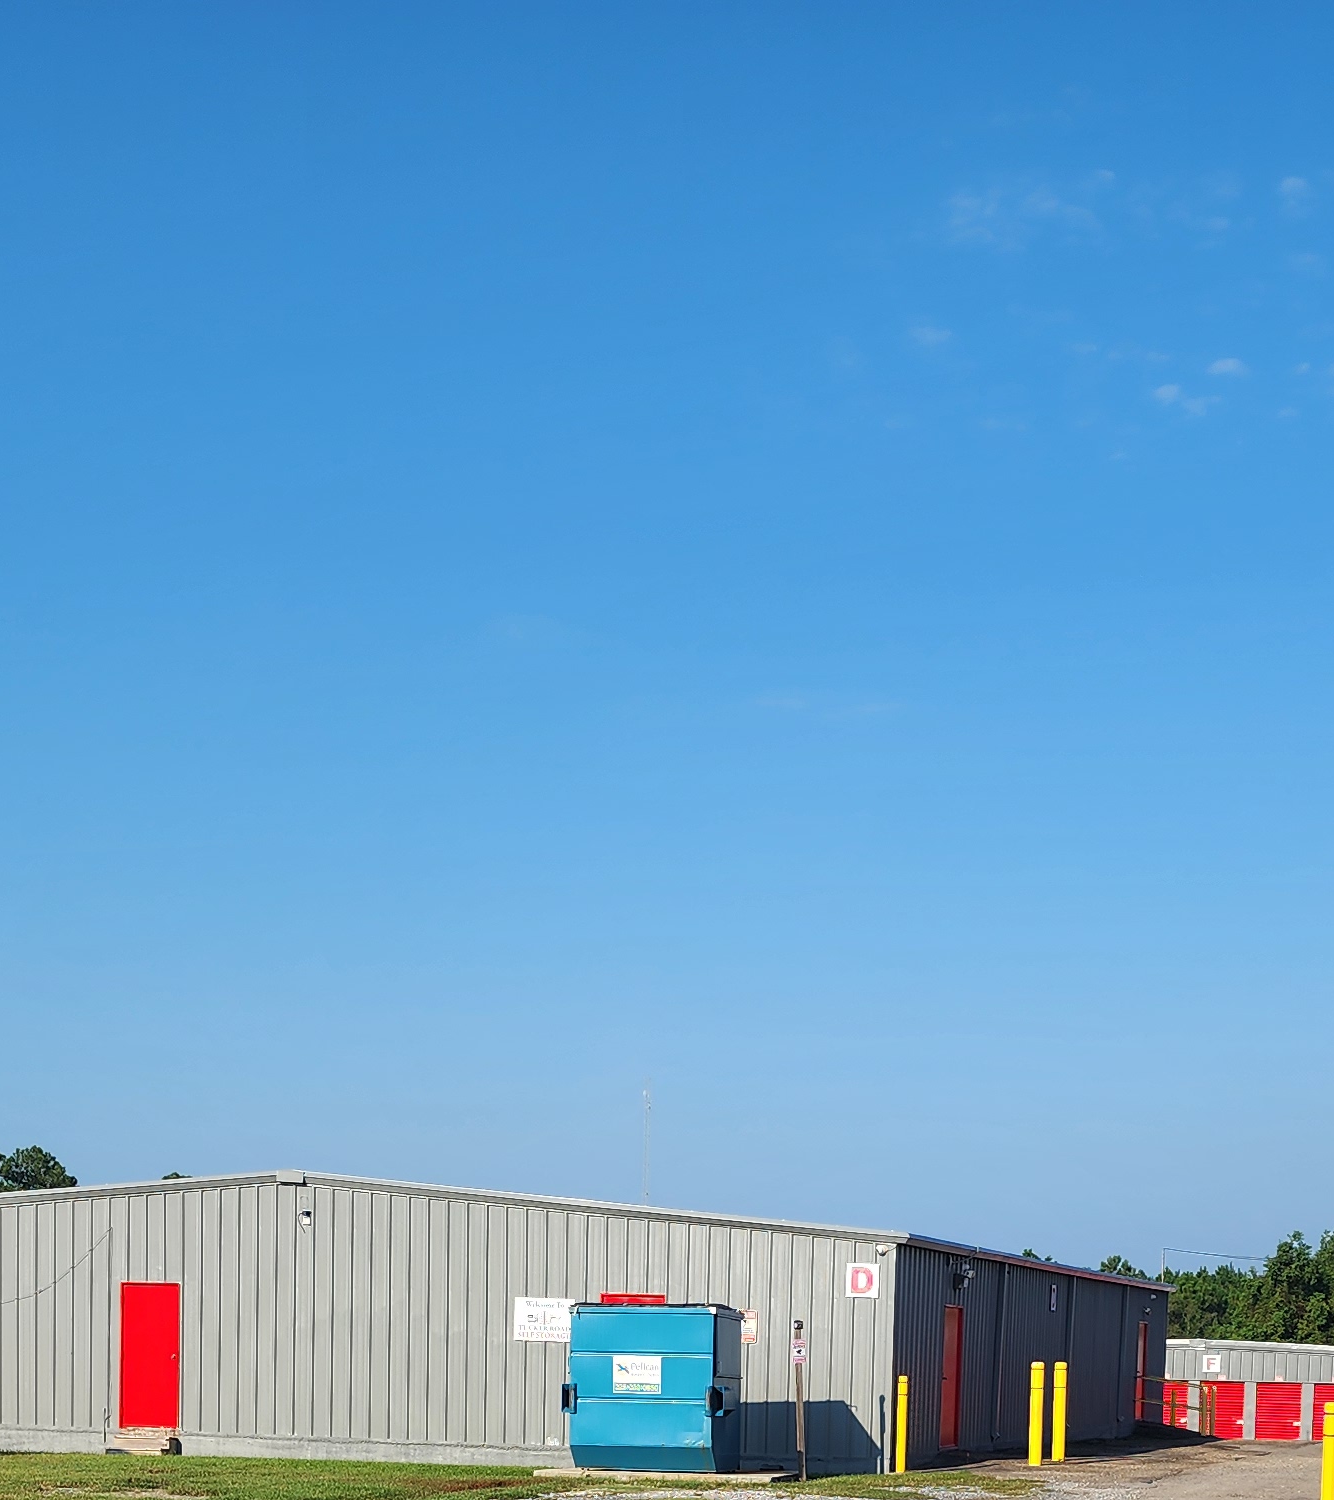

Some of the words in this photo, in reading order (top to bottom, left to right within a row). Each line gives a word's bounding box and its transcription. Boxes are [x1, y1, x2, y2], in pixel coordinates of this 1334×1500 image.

[851, 1266, 873, 1294] D
[630, 1362, 659, 1371] Pelican
[1206, 1357, 1217, 1371] F
